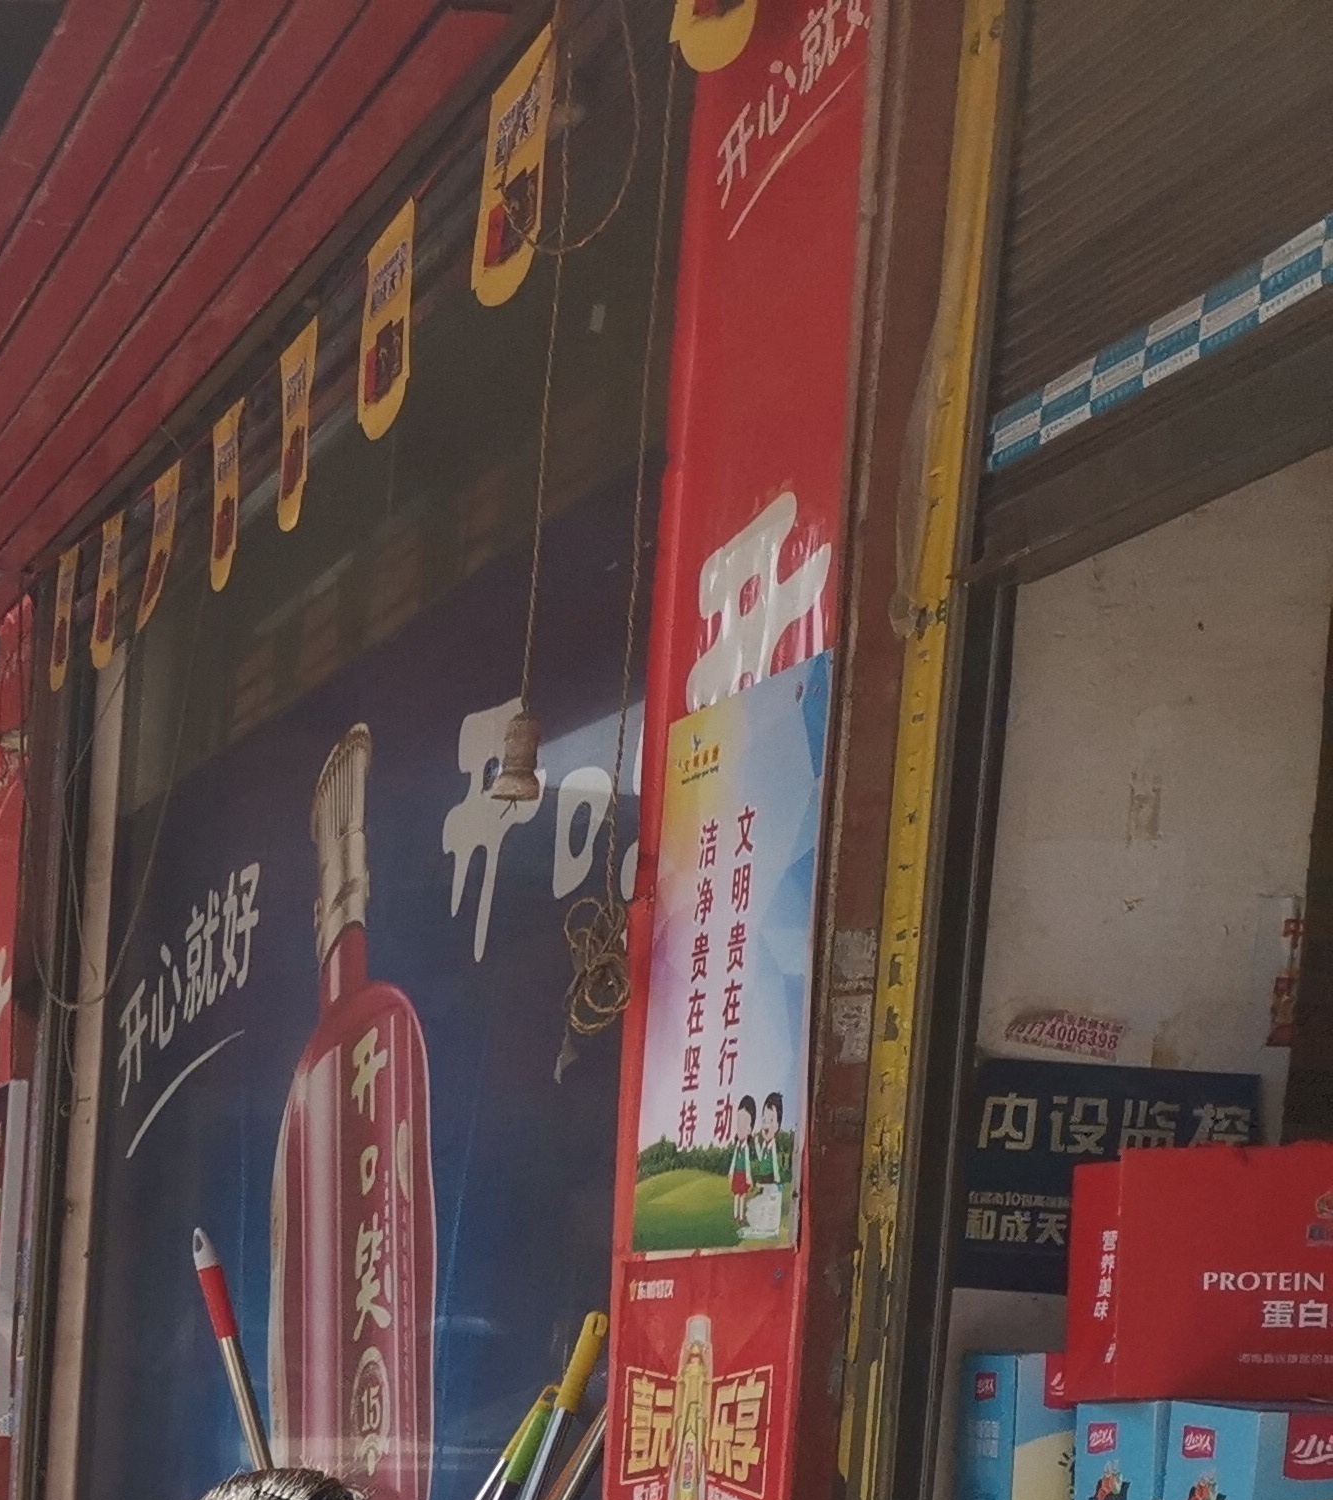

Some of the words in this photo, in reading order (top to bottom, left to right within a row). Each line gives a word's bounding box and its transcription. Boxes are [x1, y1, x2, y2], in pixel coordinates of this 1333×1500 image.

[716, 0, 871, 208] 开心就
[443, 697, 641, 962] 开口
[118, 861, 261, 1106] 开心就好
[678, 820, 720, 1147] 洁净贵在坚持
[713, 805, 757, 1142] 文明贵在行动
[351, 1026, 392, 1342] 开口笑
[965, 1207, 1067, 1246] 和成天
[977, 1093, 1255, 1155] 内设监控
[1093, 1230, 1120, 1321] 营养美味
[1203, 1271, 1325, 1292] PROTEIN
[1261, 1299, 1333, 1329] 蛋白
